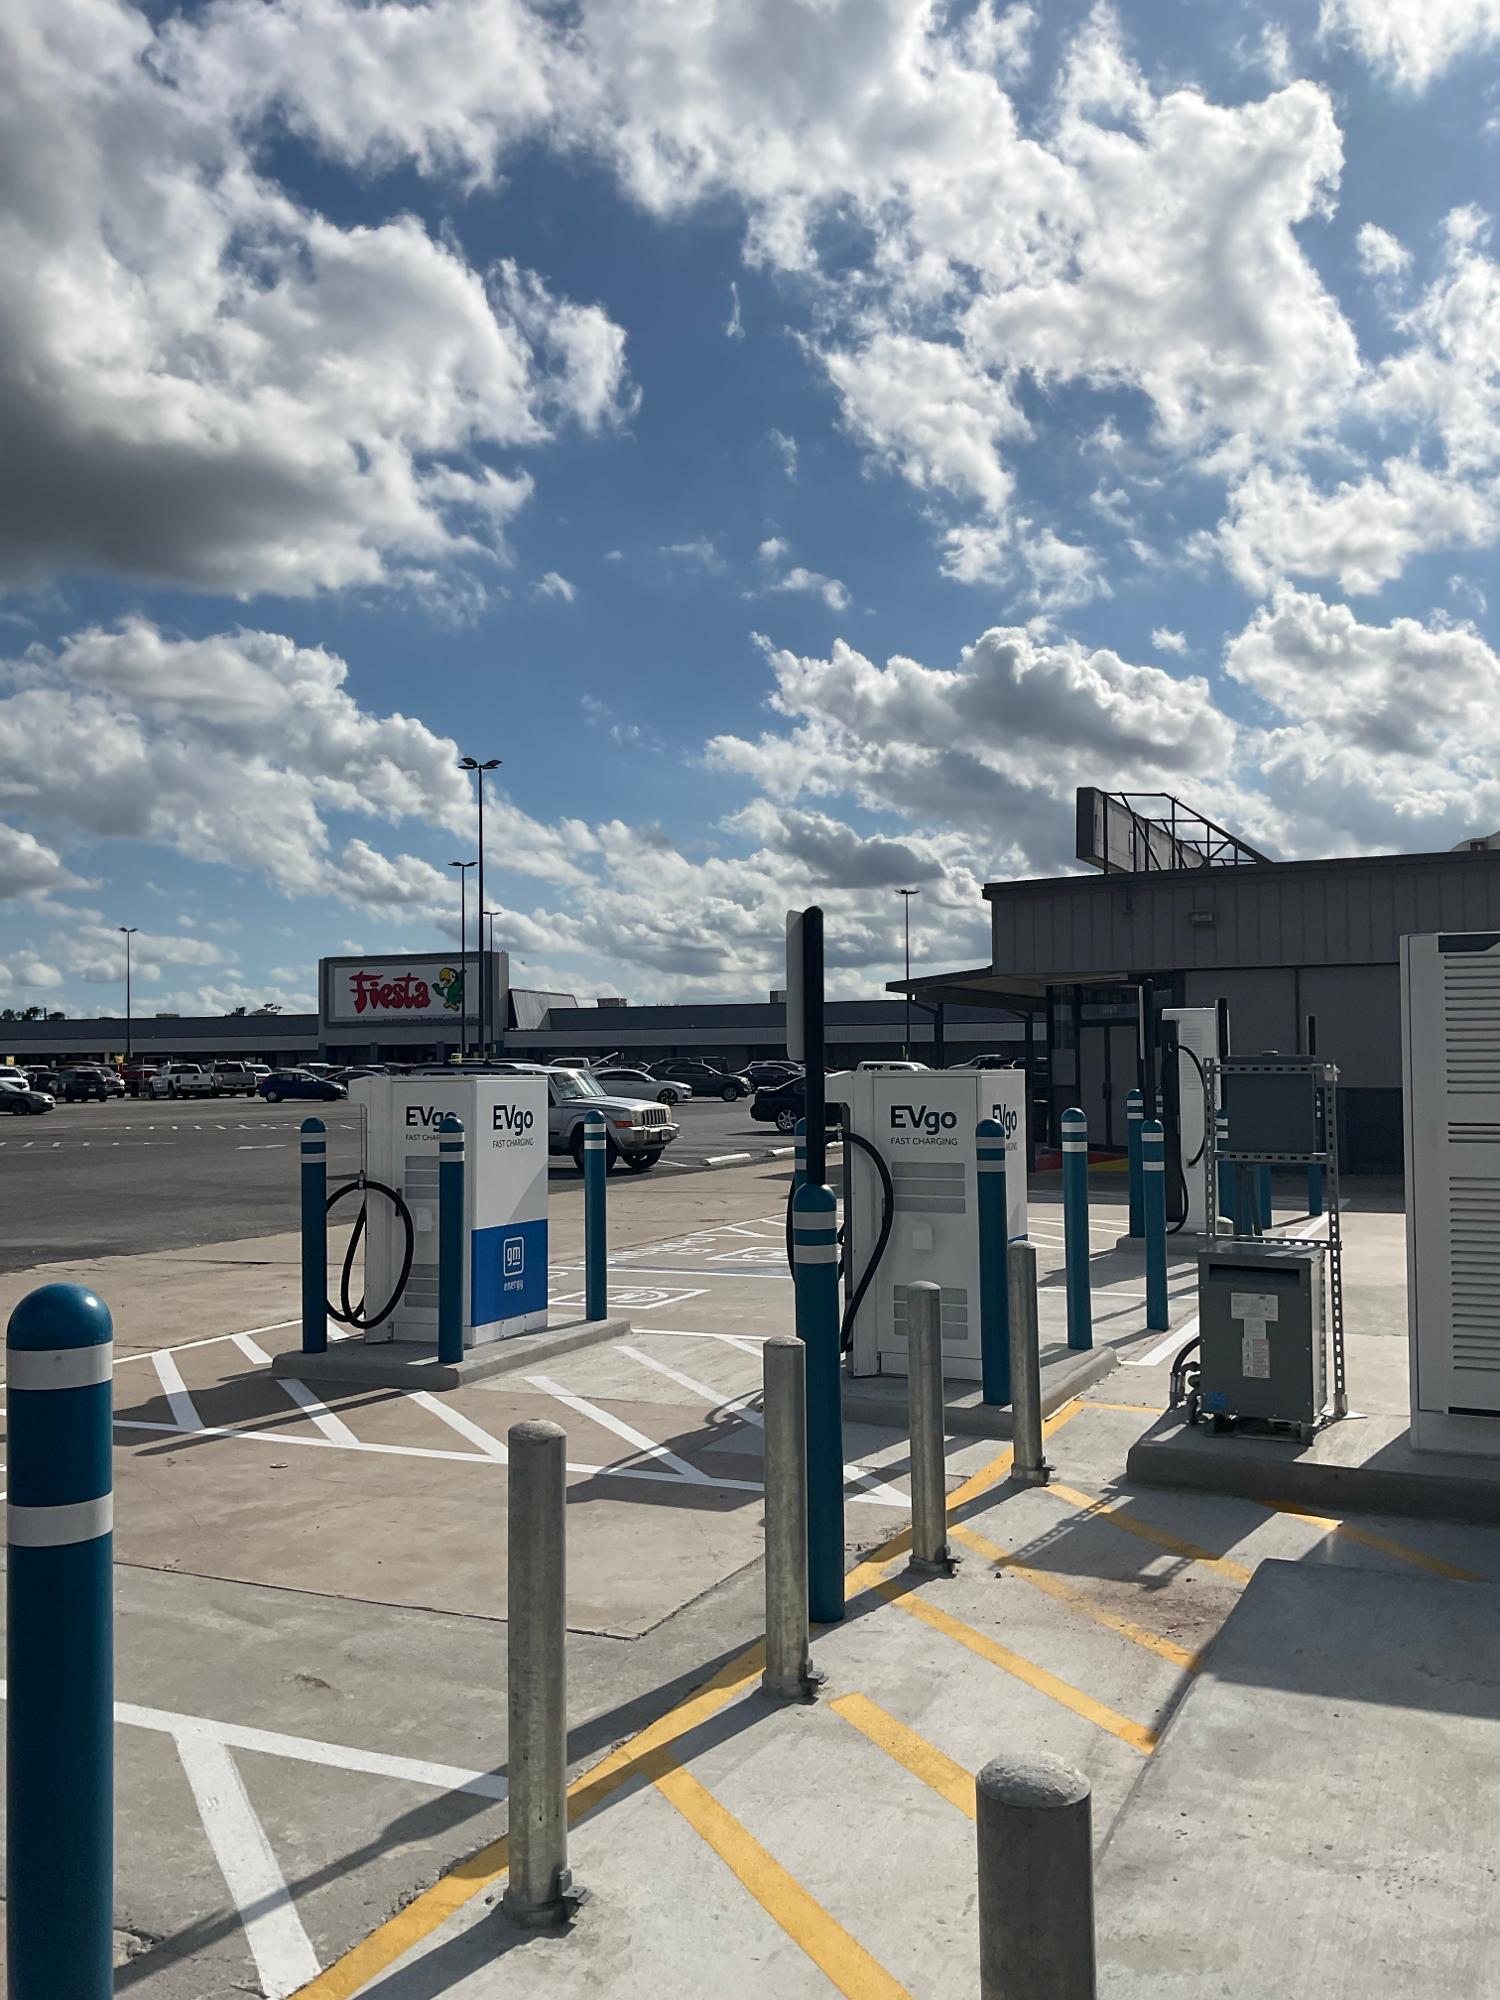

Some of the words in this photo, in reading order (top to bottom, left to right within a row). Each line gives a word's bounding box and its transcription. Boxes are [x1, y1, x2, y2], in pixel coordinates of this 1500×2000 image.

[348, 971, 432, 1014] Fiesta
[405, 1105, 457, 1133] EVg
[493, 1105, 533, 1136] EVgo
[890, 1105, 957, 1136] EVgo
[405, 1134, 421, 1142] FAST
[492, 1139, 506, 1149] FAST
[506, 1137, 534, 1148] CHARGING
[890, 1137, 911, 1146] FAST
[912, 1137, 958, 1146] CHARGING
[507, 1246, 521, 1266] gm
[503, 1279, 524, 1291] energy
